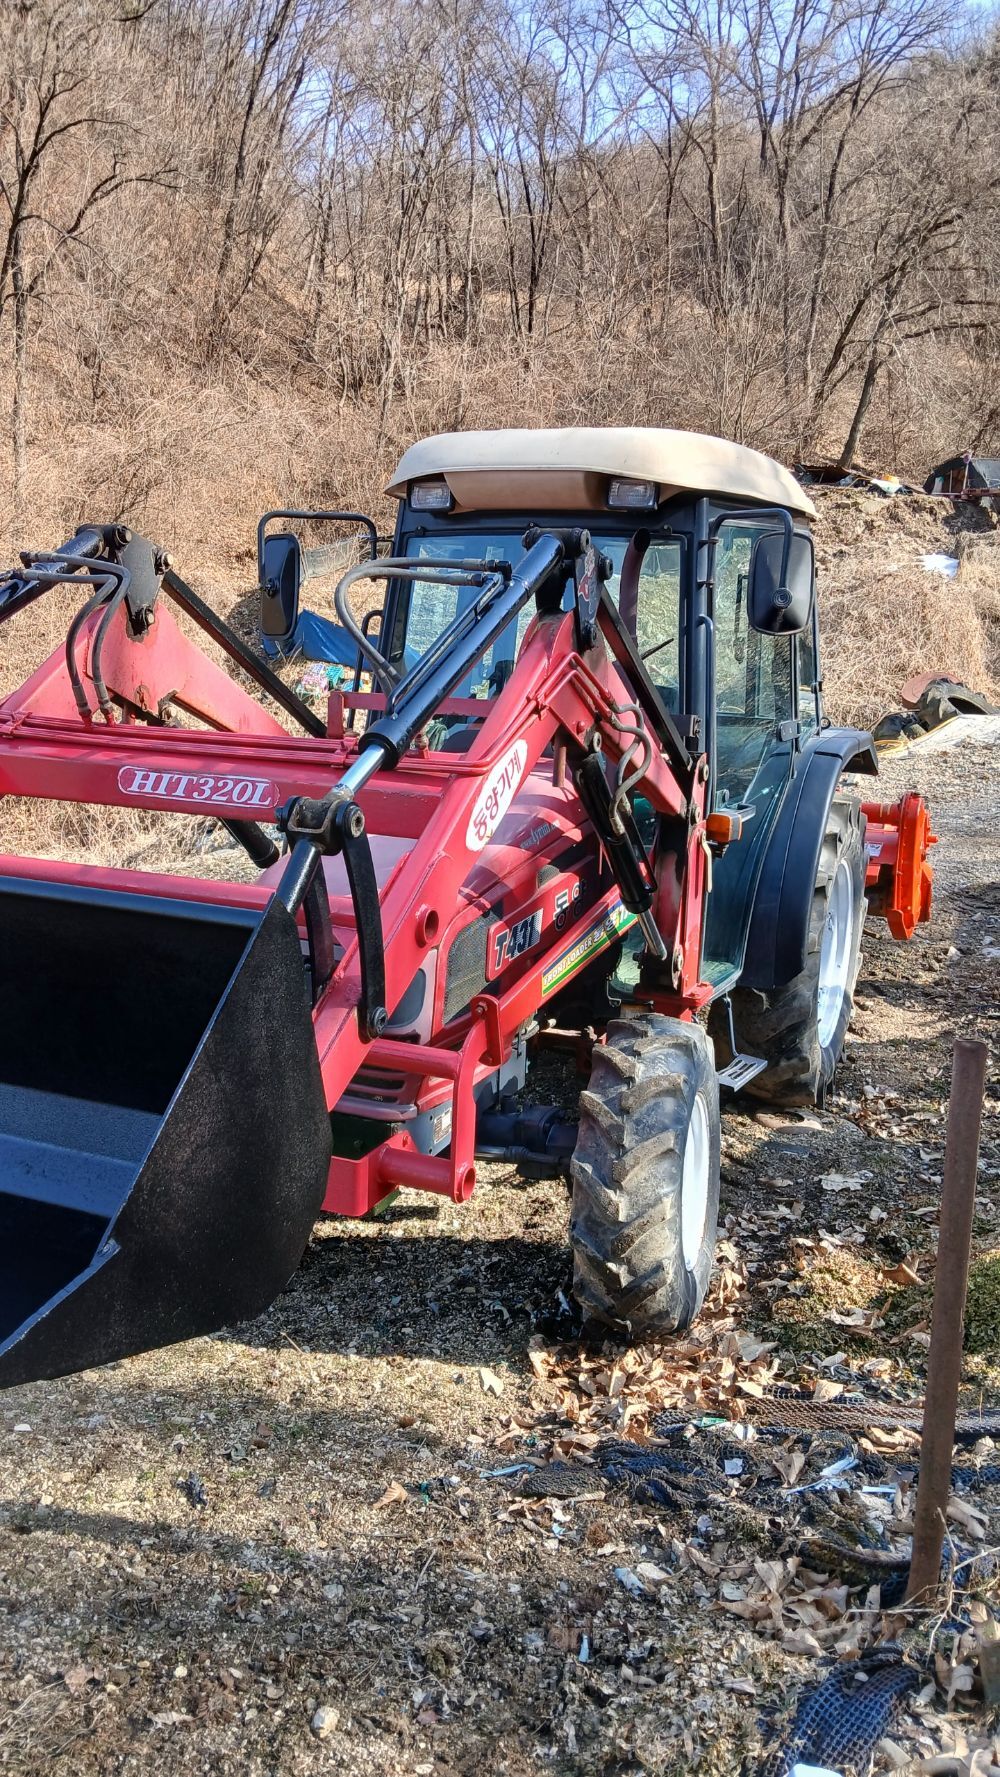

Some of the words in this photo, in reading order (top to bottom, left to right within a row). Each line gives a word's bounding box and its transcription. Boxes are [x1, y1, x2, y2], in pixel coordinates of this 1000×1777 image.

[130, 769, 272, 806] HIT320L
[473, 748, 521, 842] 동양기계
[495, 908, 544, 971] T431
[543, 961, 567, 986] FRONT
[566, 936, 593, 966] LOADER
